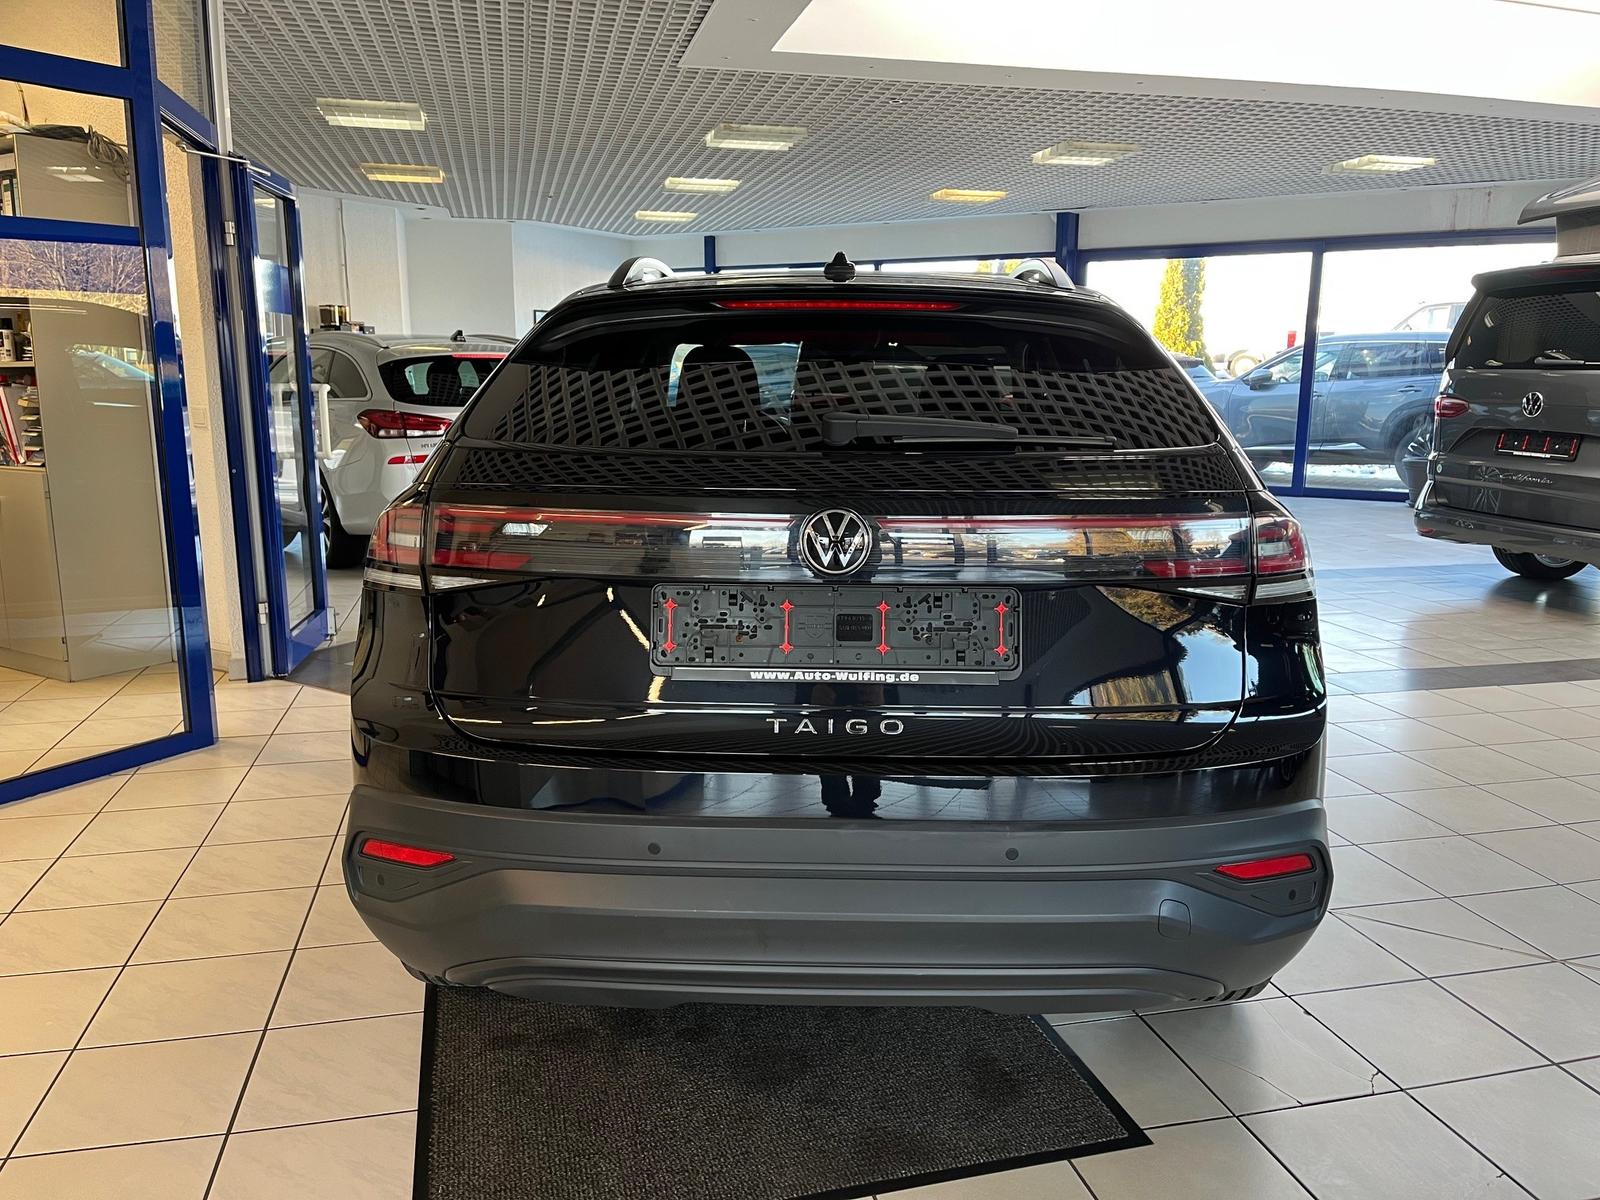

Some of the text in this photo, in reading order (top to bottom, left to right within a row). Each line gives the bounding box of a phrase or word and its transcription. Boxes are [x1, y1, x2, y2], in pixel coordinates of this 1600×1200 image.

[801, 508, 871, 576] VW
[750, 670, 919, 683] www.Auto-Wulfing.de
[766, 718, 904, 735] TAIGO
